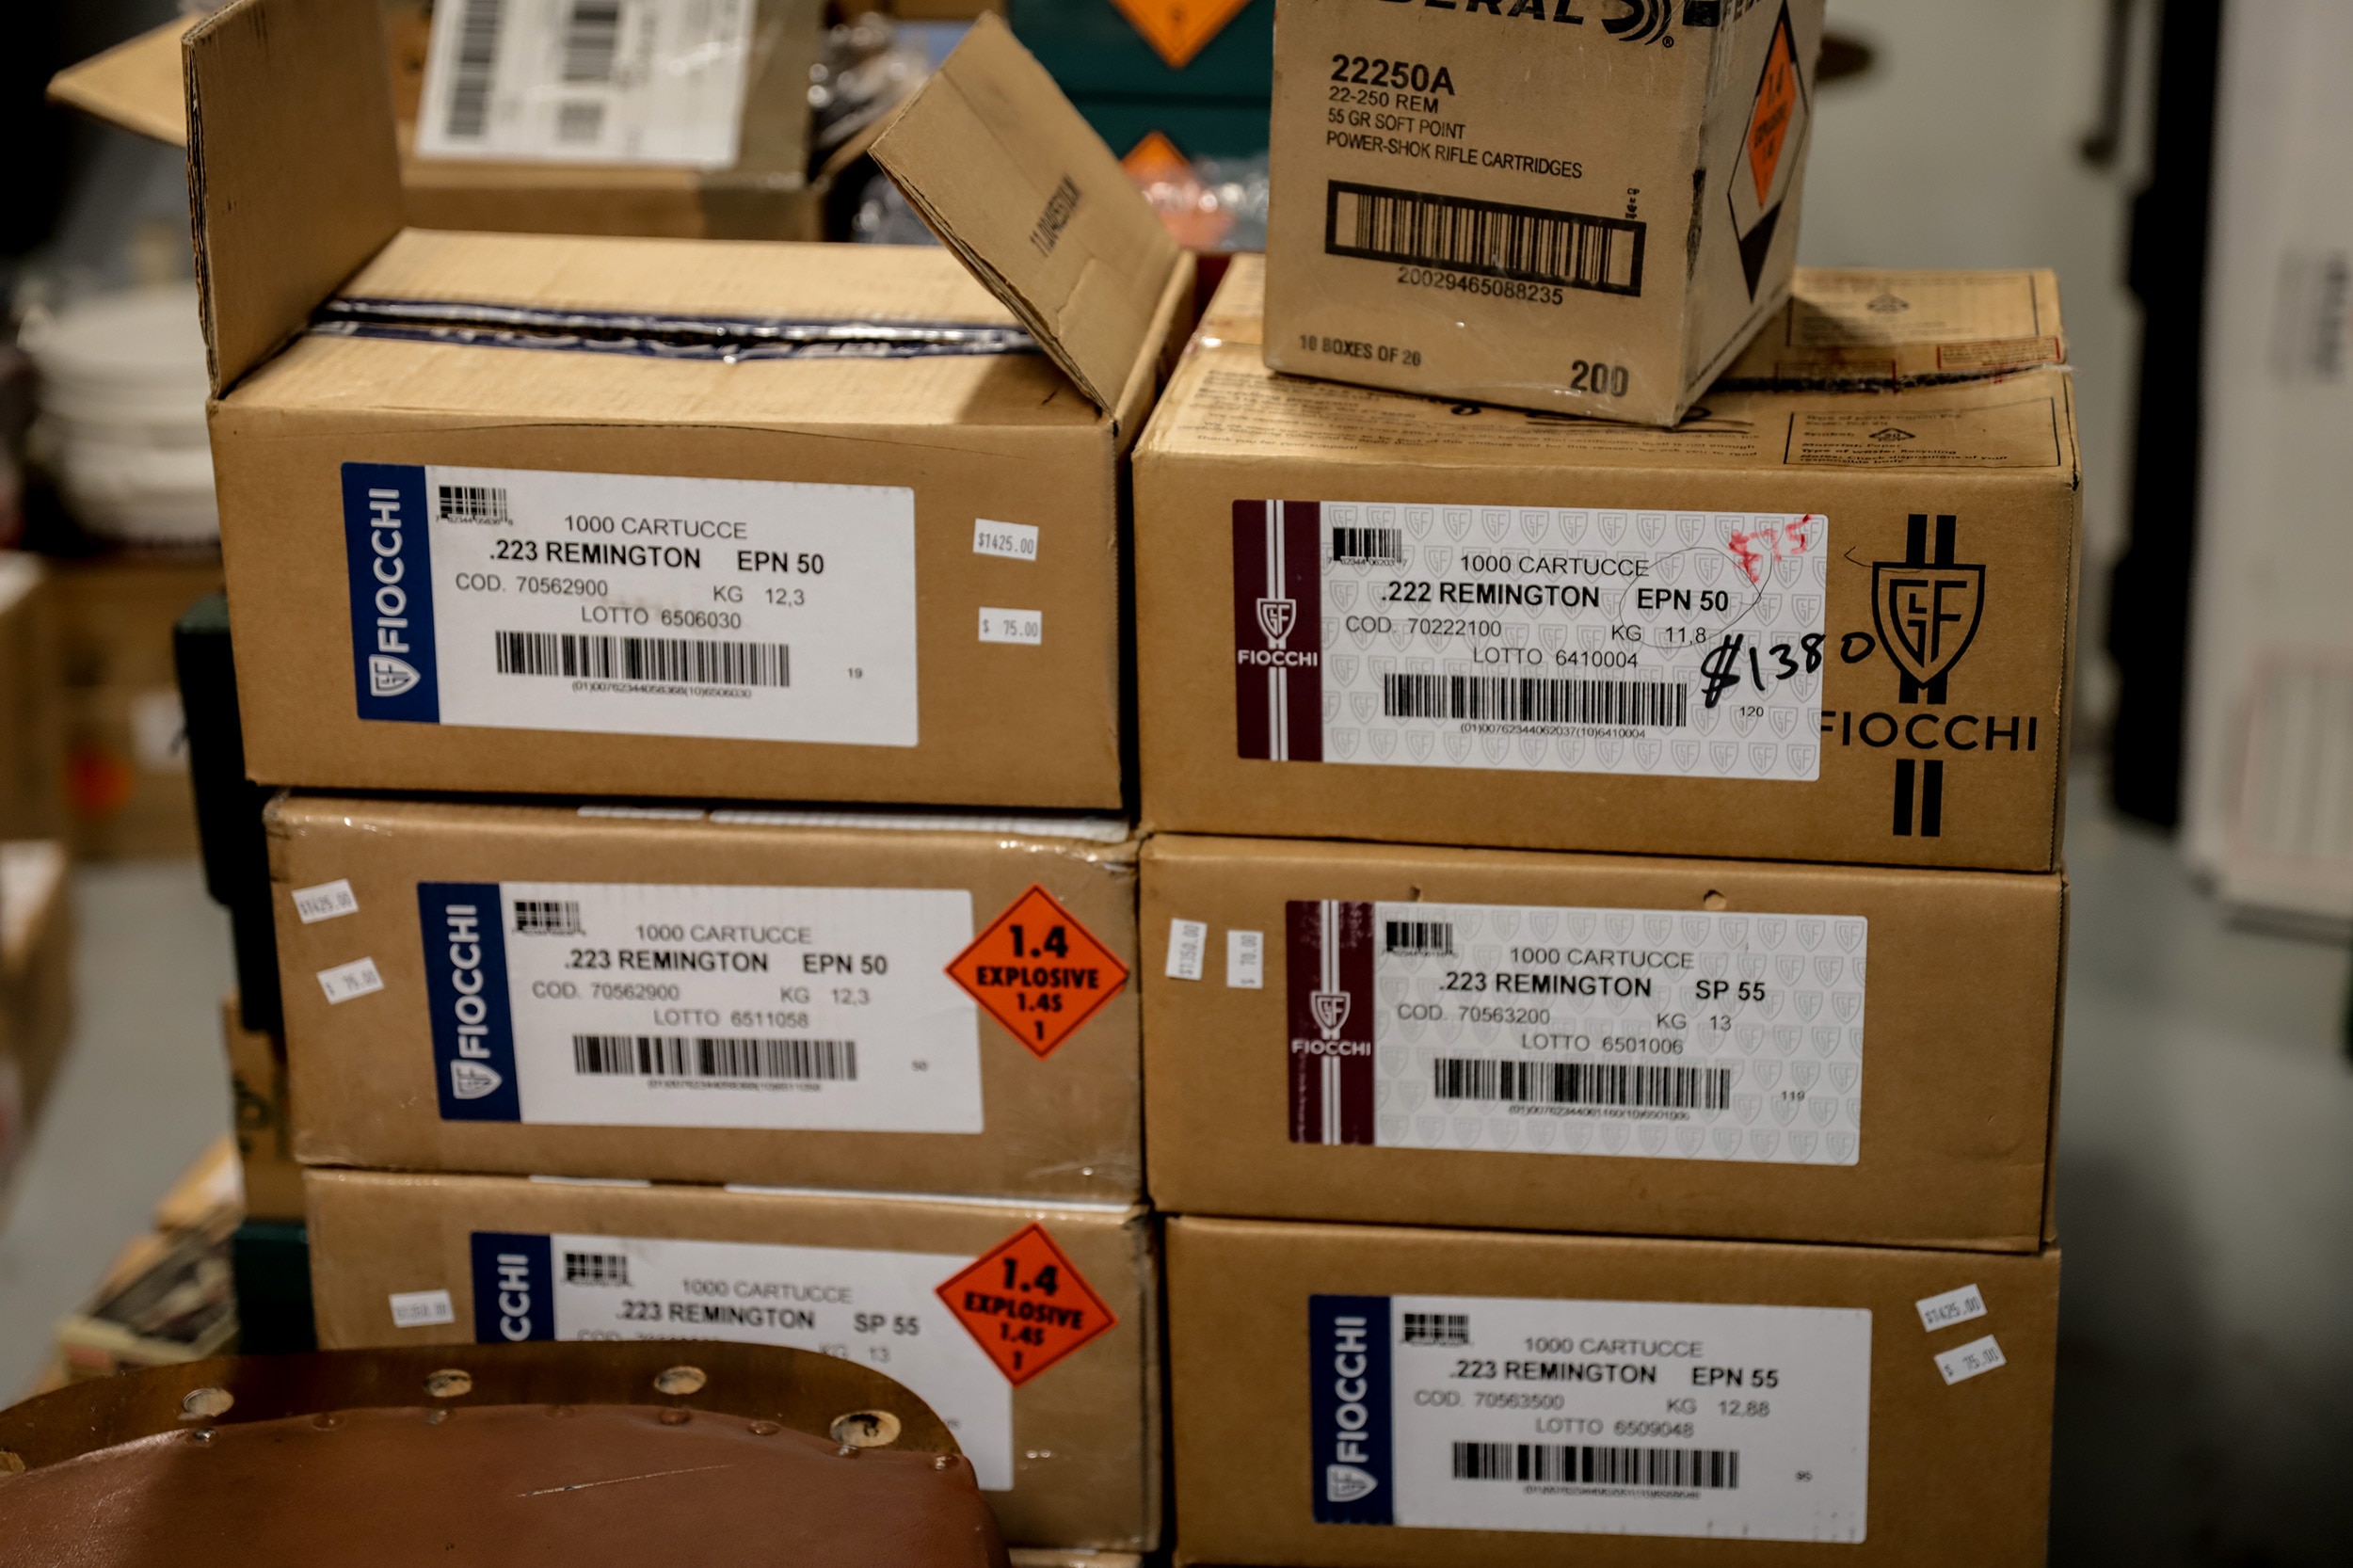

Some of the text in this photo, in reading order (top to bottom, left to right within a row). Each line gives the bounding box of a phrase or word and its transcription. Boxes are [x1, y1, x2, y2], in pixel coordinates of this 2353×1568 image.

[1331, 55, 1455, 95] 22250A
[1328, 86, 1440, 114] 22-250 REM
[1328, 107, 1465, 139] 55 GR SOFT POINT
[1326, 131, 1583, 179] POWER-SHOK RIFLE CARTRIDGES
[1397, 265, 1564, 305] 20029465088235
[1321, 336, 1373, 359] BOXES
[1378, 344, 1400, 362] OF
[1402, 349, 1422, 366] 20
[1570, 359, 1630, 398] 200
[565, 515, 748, 540] 1000 CARTUCCE
[978, 532, 1034, 554] $1425.00
[489, 540, 824, 575] .223 REMINGTON EPN 50
[1461, 554, 1649, 577] 1000 CARTUCCE
[368, 488, 409, 653] FIOCCHI
[456, 573, 806, 608] COD. 70562900 KG 12,3
[1382, 581, 1729, 612] .222 REMINGTON EPN 50
[582, 606, 742, 630] LOTTO 6506030
[1003, 619, 1038, 637] 75.00
[1346, 616, 1706, 645] COD. 70222100 KG 11,8
[1238, 649, 1318, 666] FIOCCHI
[1474, 647, 1639, 668] LOTTO 6410004
[847, 667, 863, 679] 19
[1740, 707, 1765, 717] 120
[1460, 723, 1645, 739] (01)00762344062037(10)6410004
[636, 924, 812, 945] 1000 CARTUCCE
[1009, 924, 1069, 958] 1.4
[565, 950, 888, 975] .223 REMINGTON EPN 50
[1511, 948, 1694, 969] 1000 CARTUCCE
[446, 904, 490, 1059] FIOCCHI
[976, 966, 1099, 989] EXPLOSIVE
[1439, 971, 1766, 1001] .223 REMINGTON SP 55
[532, 981, 871, 1006] COD. 70562900 KG 12,3
[1017, 993, 1063, 1012] 1.4S
[654, 1010, 809, 1029] LOTTO 6511058
[1034, 1020, 1045, 1041] 1
[1398, 1004, 1732, 1032] COD. 70563200 KG 13
[1291, 1039, 1371, 1056] FIOCCHI
[1522, 1034, 1684, 1055] LOTTO 6501006
[1002, 1258, 1058, 1296] 1.4
[497, 1254, 532, 1341] CCHI
[682, 1278, 852, 1304] 1000 CARTUCCE
[616, 1300, 920, 1336] .223 REMINGTON SP 55
[965, 1290, 1085, 1331] EXPLOSIVE
[1000, 1321, 1045, 1347] 1.4S
[869, 1347, 890, 1364] 13
[1526, 1336, 1705, 1358] 1000 CARTUCCE
[1013, 1350, 1022, 1370] 1
[1449, 1360, 1779, 1388] .223 REMINGTON EPN 55
[1335, 1317, 1369, 1463] FIOCCHI
[1415, 1390, 1463, 1408] COD.
[1474, 1391, 1564, 1410] 70563500
[1667, 1398, 1697, 1415] KG
[1536, 1417, 1694, 1438] LOTTO 6509048
